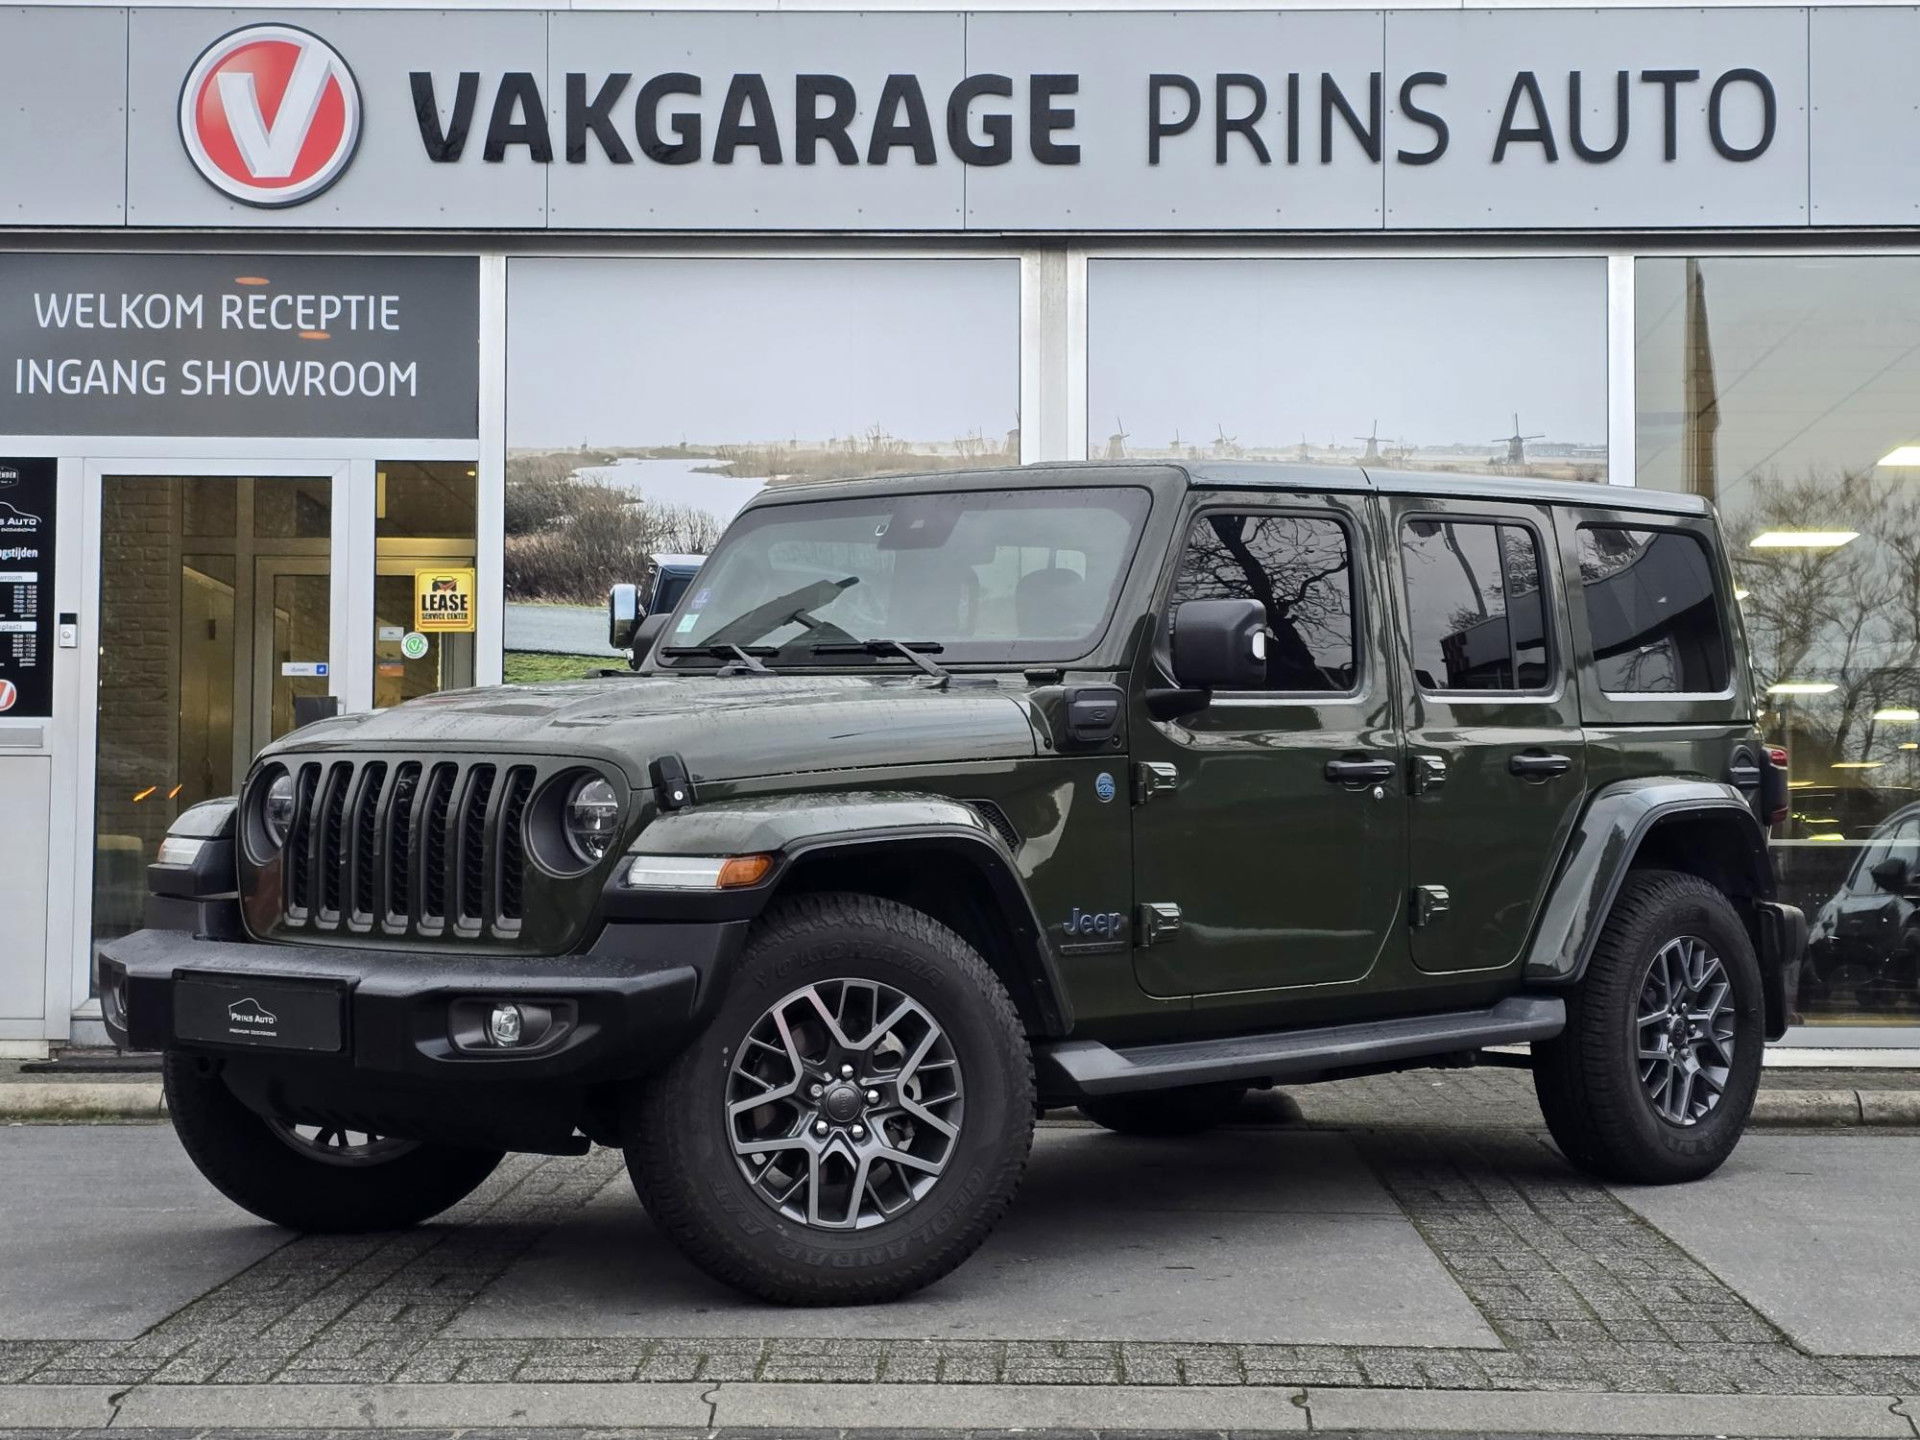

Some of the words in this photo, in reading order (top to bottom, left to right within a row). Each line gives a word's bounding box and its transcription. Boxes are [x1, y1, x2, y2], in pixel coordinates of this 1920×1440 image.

[409, 72, 1081, 165] VAKGARAGE
[1148, 72, 1450, 166] PRINS
[1492, 68, 1777, 163] AUTO
[33, 292, 204, 330] WELKOM
[220, 293, 401, 332] RECEPTIE
[15, 357, 166, 396] INGANG
[181, 359, 418, 398] SHOWROOM
[7, 517, 37, 526] AUTO
[422, 593, 468, 612] LEASE
[1062, 906, 1121, 938] Jeep
[753, 937, 947, 989] YOKOHAMA
[231, 1012, 254, 1022] PRINS
[254, 1014, 275, 1025] AUTO
